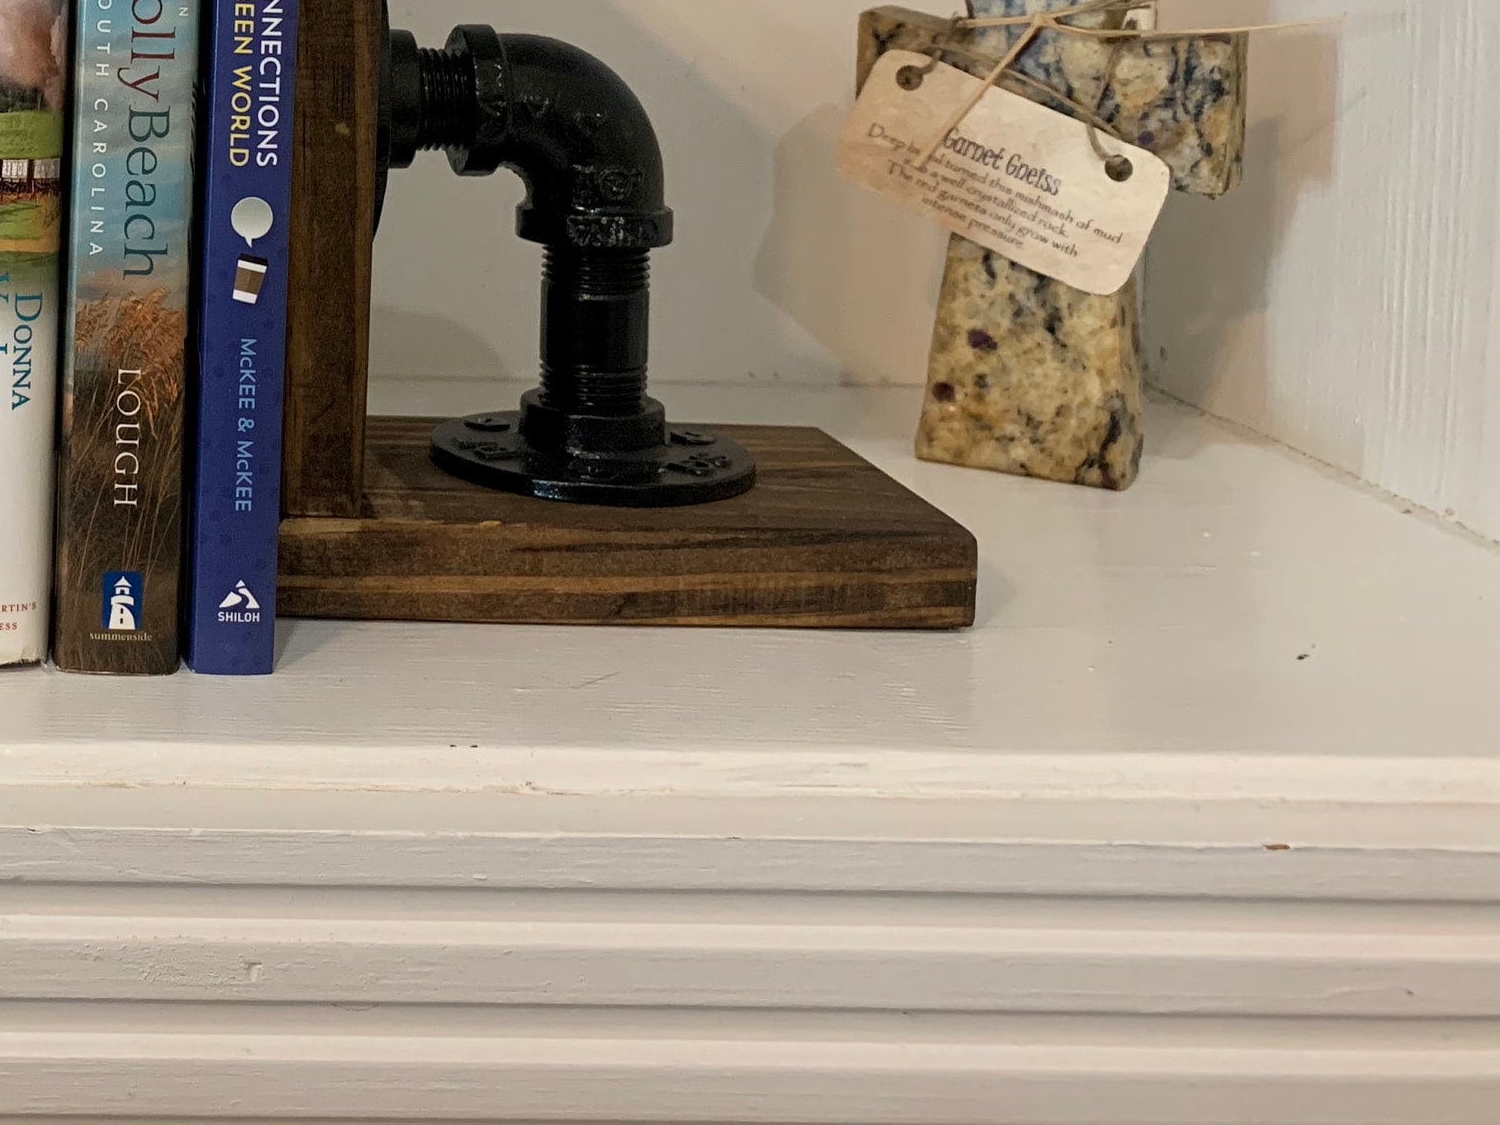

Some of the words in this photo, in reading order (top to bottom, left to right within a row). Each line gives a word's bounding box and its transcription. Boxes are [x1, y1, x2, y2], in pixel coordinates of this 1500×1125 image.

[228, 65, 255, 168] WORLD
[88, 97, 109, 257] CAROLINA
[122, 104, 172, 277] Beach
[942, 126, 1006, 170] Garnet
[1006, 153, 1061, 195] Gneiss
[887, 159, 913, 181] The
[1051, 239, 1078, 257] with
[1075, 218, 1095, 231] of
[1093, 228, 1124, 244] mud
[237, 337, 259, 411] McKEE
[113, 366, 143, 507] LOUGH
[237, 416, 255, 433] &
[234, 440, 255, 512] McKEE
[88, 631, 153, 642] summerside
[216, 610, 261, 623] SHILOH
